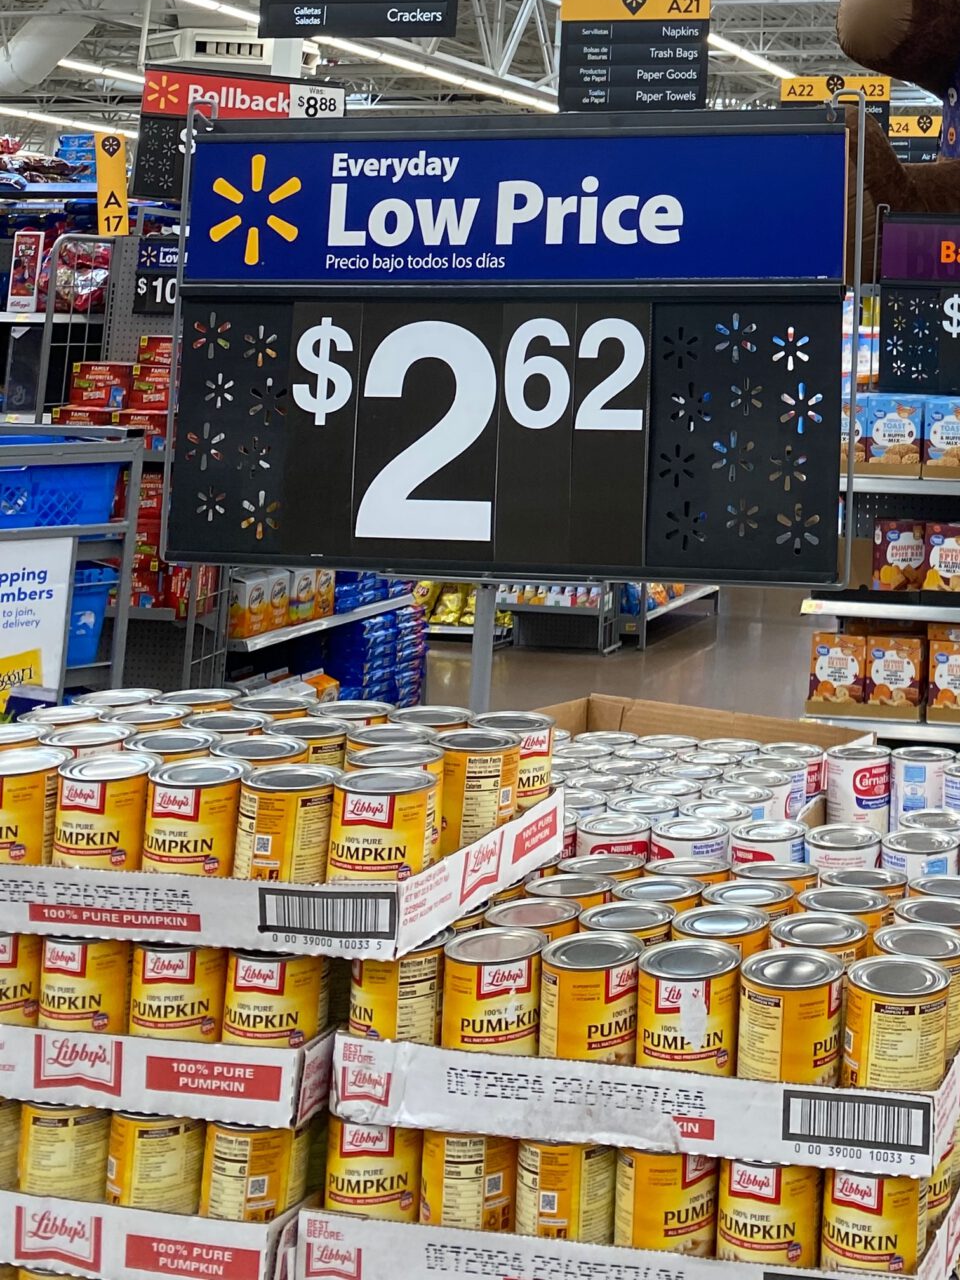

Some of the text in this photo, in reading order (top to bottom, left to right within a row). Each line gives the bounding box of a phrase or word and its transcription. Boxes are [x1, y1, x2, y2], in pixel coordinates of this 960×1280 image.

[387, 8, 442, 21] Crackers
[662, 26, 699, 39] Napkins
[650, 47, 698, 61] Trash Bags
[637, 68, 697, 82] Paper Goods
[188, 84, 290, 114] Rollback
[309, 87, 325, 95] Was:
[636, 90, 696, 103] Paper Towels
[787, 84, 814, 97] A22
[332, 150, 460, 183] Everyday
[104, 191, 122, 209] A
[328, 176, 684, 248] Low Price
[104, 215, 123, 232] 17
[325, 252, 505, 272] Precio bajo todos los días
[2, 618, 41, 629] delivery
[65, 783, 95, 801] Libby's
[156, 791, 189, 809] Libby's
[351, 798, 384, 816] Libby's
[331, 839, 406, 861] PUMPKIN
[362, 837, 382, 845] PURE
[42, 908, 188, 927] 100% PURE PUMPKIN
[272, 933, 383, 950] 0 00 39000 10033 5
[46, 946, 76, 965] Libby's
[151, 953, 185, 971] Libby's
[242, 961, 275, 980] Libby's
[488, 967, 524, 986] Libby's
[163, 995, 184, 1003] PURE
[132, 998, 209, 1021] PUMPKIN
[225, 1006, 299, 1029] PUMPKIN
[255, 1005, 273, 1013] PURE
[46, 1038, 109, 1068] Libby's
[343, 1043, 363, 1053] BEST
[171, 1062, 254, 1079] 100% PURE
[350, 1069, 385, 1088] Libby's
[178, 1076, 245, 1093] PUMPKIN
[349, 1129, 384, 1146] Libby's
[794, 1143, 916, 1165] 0 00 39000 10033 5
[328, 1172, 408, 1195] PUMPKIN
[734, 1170, 771, 1190] Libby's
[837, 1179, 873, 1198] Libby's
[28, 1210, 88, 1243] Libby's
[720, 1209, 796, 1240] PUMPKIN
[750, 1213, 771, 1222] PURE
[823, 1217, 898, 1250] PUMPKIN
[852, 1223, 872, 1232] PURE
[151, 1241, 233, 1262] 100% PURE
[315, 1246, 353, 1265] Libby's
[158, 1256, 224, 1275] PUMPKIN
